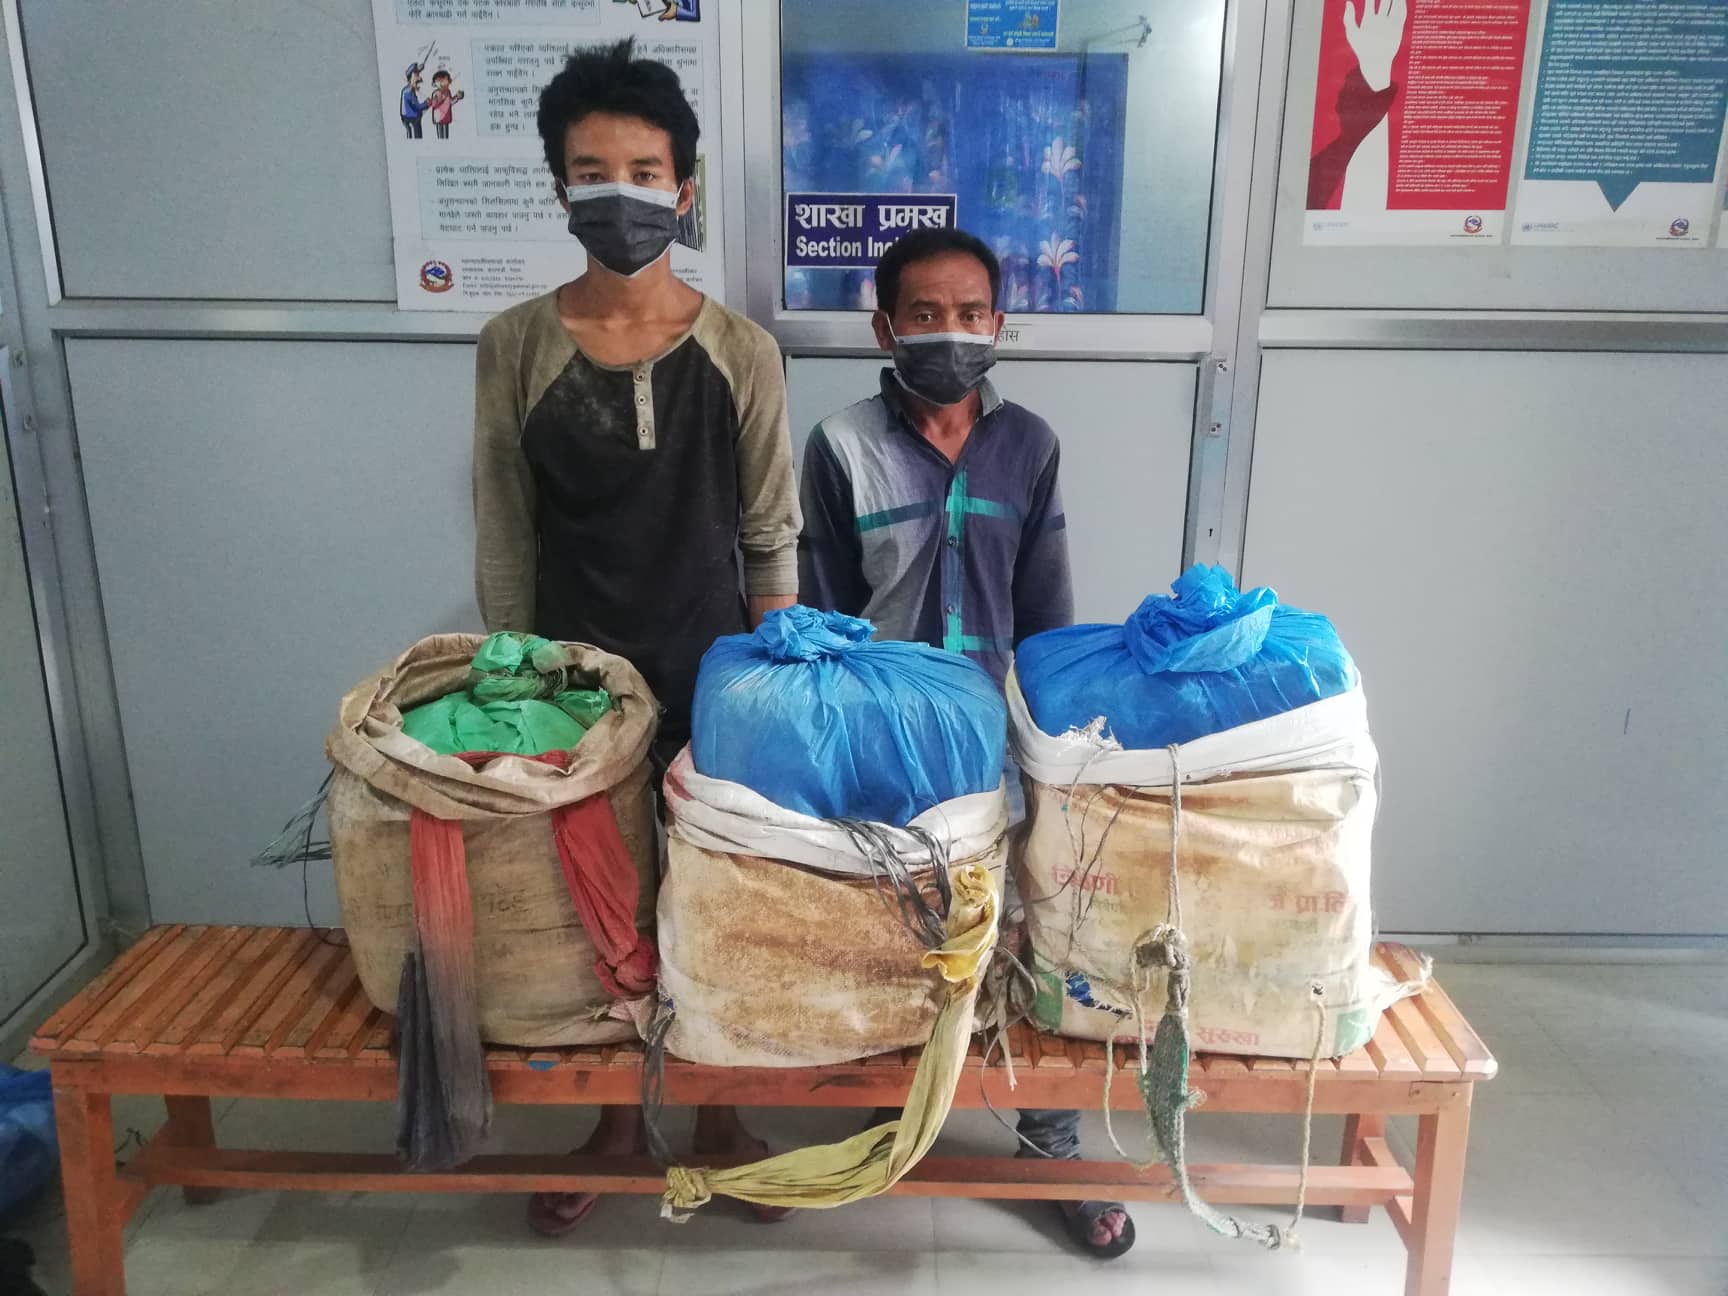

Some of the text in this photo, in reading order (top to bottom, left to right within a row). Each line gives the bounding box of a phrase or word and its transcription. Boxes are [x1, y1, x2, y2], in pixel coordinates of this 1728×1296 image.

[795, 204, 950, 231] शाखा प्रमख
[796, 235, 862, 257] Section
